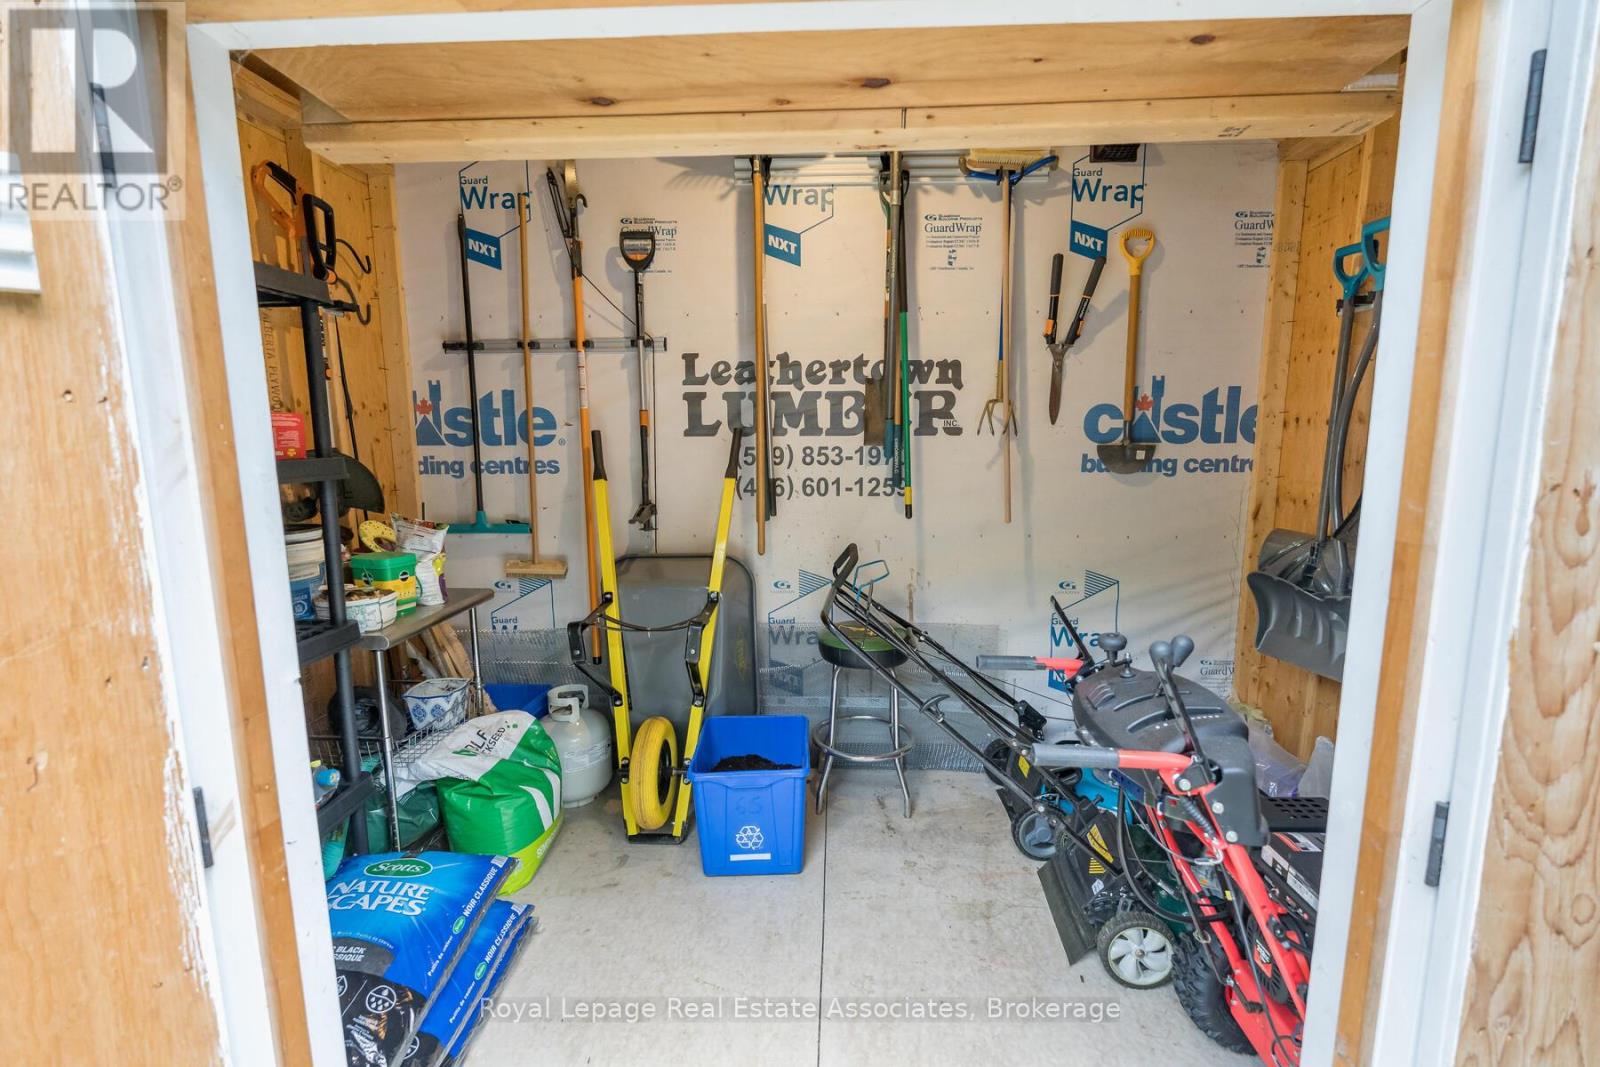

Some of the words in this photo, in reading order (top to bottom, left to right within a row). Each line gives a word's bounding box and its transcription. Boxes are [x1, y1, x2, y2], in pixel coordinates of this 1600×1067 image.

[460, 176, 488, 185] Guard
[1073, 168, 1103, 177] Guard
[765, 184, 834, 212] Wrap
[1073, 178, 1144, 209] Wrap
[924, 223, 982, 235] GuardWrap
[467, 239, 497, 258] NXT
[768, 234, 797, 255] NXT
[1074, 232, 1103, 252] NXT
[682, 390, 963, 437] LUMBR
[736, 475, 794, 500] (46)
[491, 616, 518, 624] Guard
[769, 617, 795, 625] Guard
[769, 625, 818, 646] Wra
[1051, 626, 1101, 648] Wra
[373, 862, 424, 873] Scotts
[327, 878, 434, 901] NATURE
[463, 898, 477, 918] NOIR
[474, 866, 498, 900] CLASSIQUE
[336, 945, 367, 954] BLACK
[484, 944, 498, 964] NOIR
